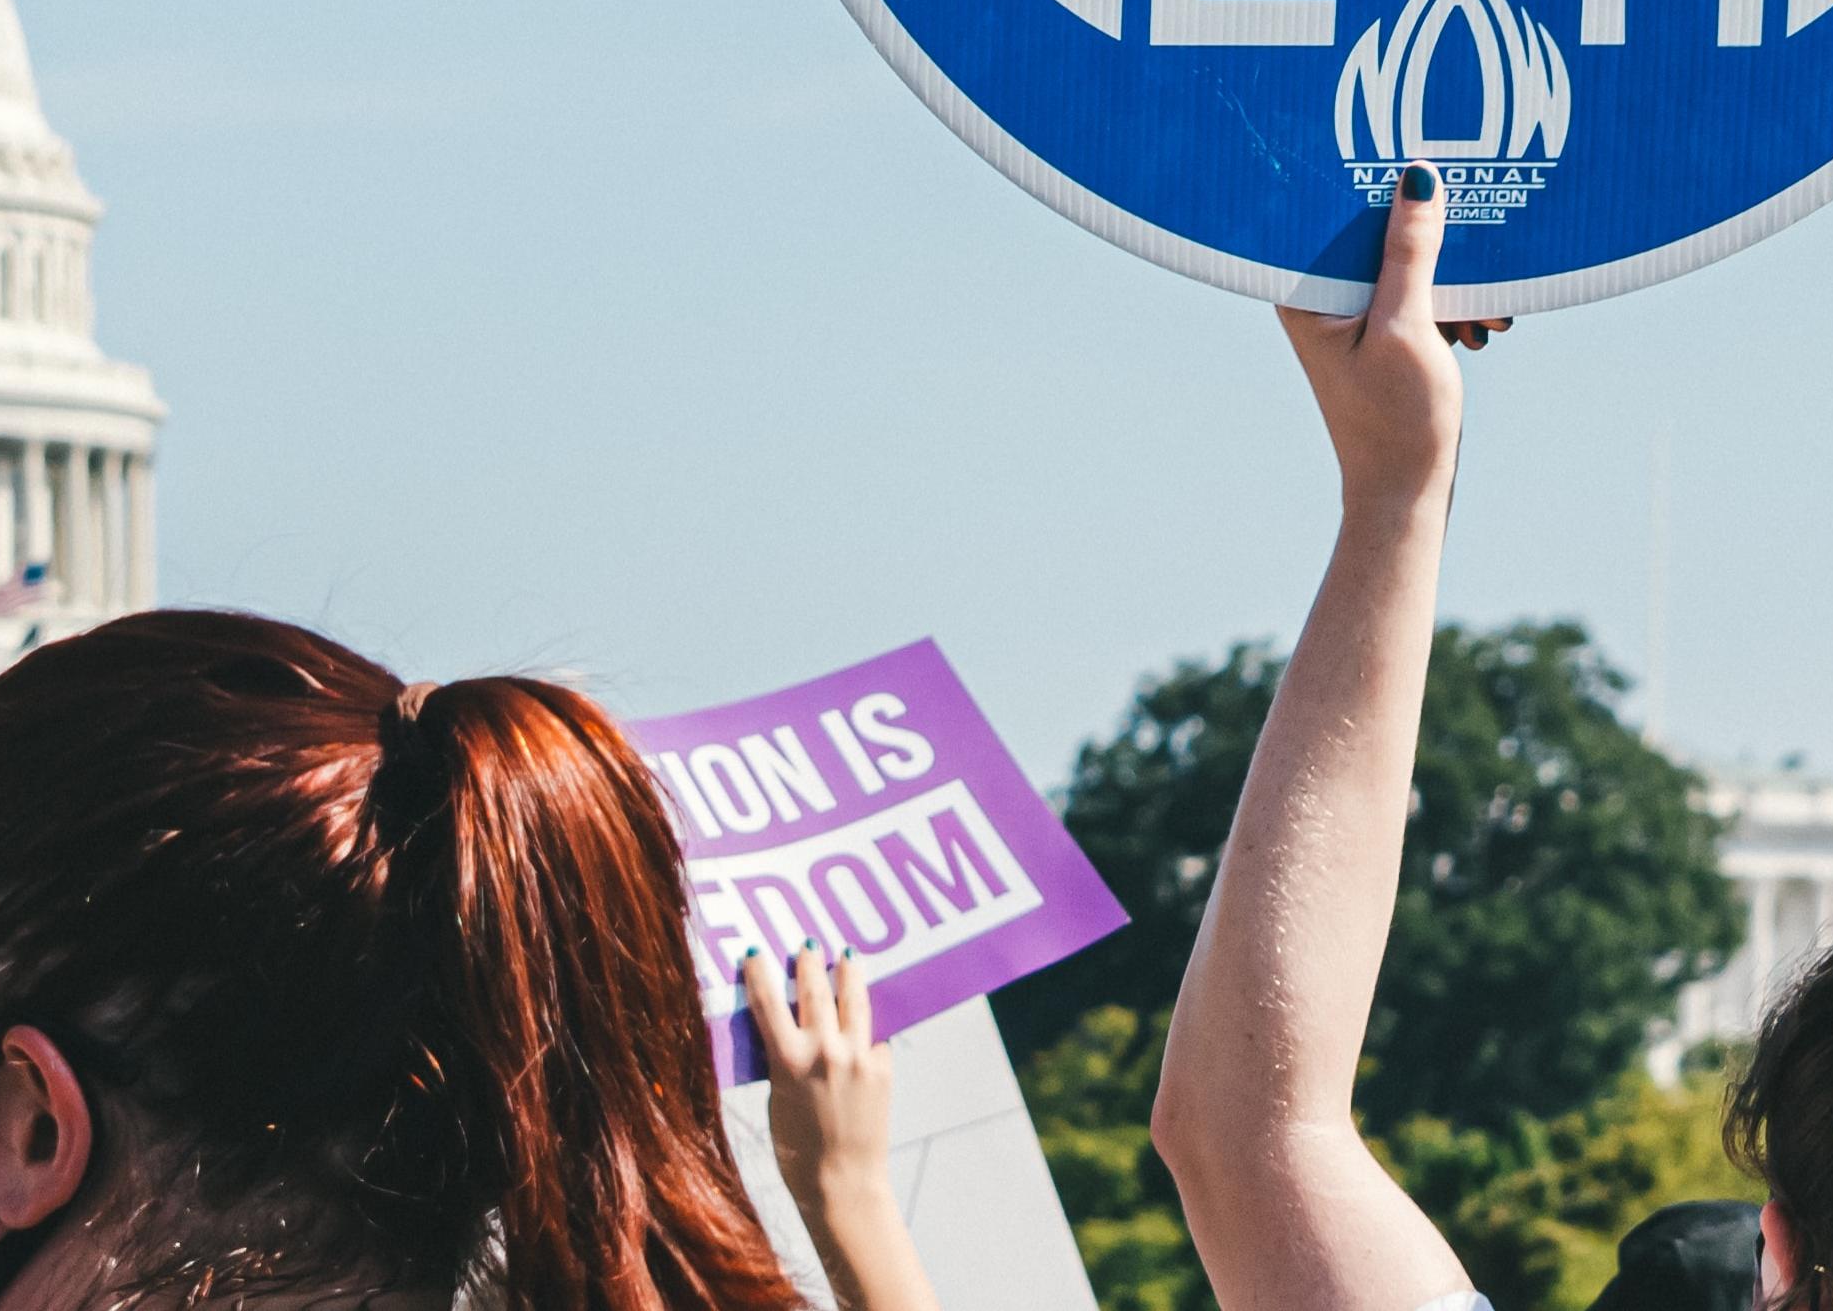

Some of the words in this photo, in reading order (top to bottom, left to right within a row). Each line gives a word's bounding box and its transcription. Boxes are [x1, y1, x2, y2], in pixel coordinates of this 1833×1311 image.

[1353, 167, 1546, 184] NAONAL
[819, 692, 935, 795] IS
[693, 806, 1011, 985] EDOM
